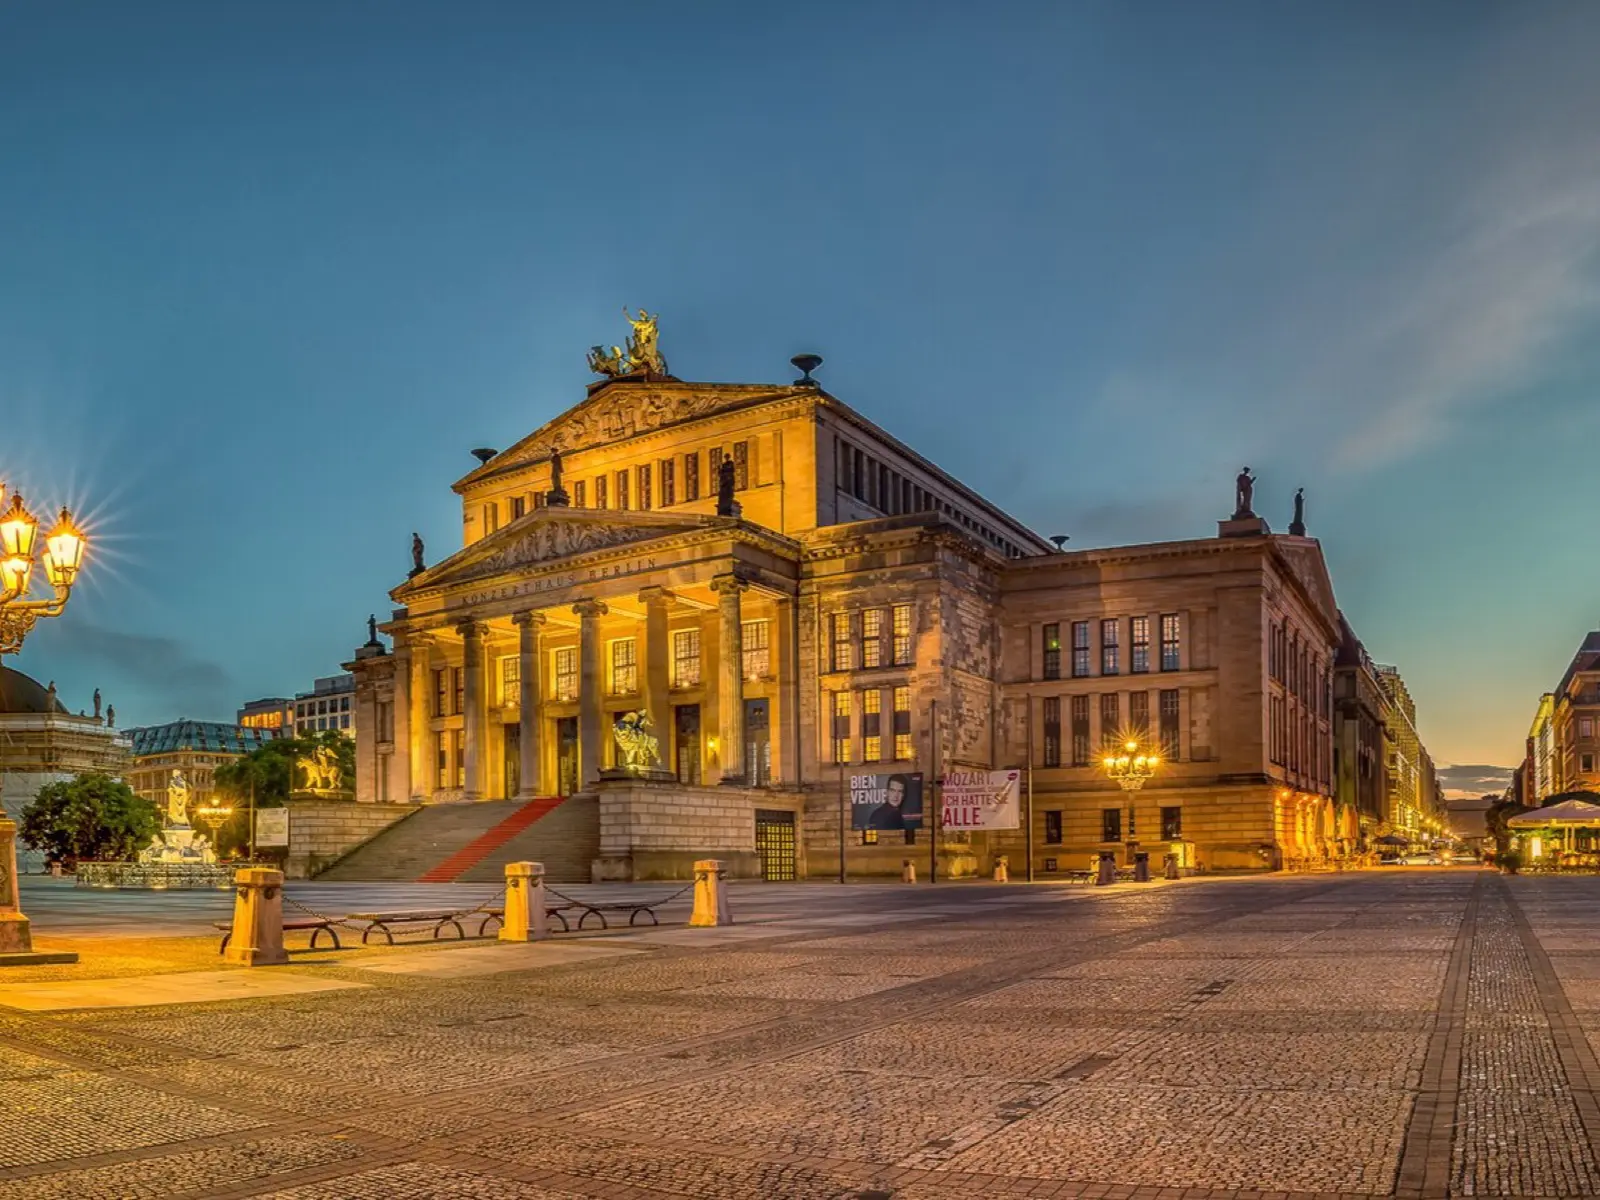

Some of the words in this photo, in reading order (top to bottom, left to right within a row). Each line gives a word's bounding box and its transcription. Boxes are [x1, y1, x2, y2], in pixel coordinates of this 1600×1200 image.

[462, 574, 576, 604] KONZERTHAUS
[589, 558, 656, 582] BERLIN
[851, 775, 877, 789] BIEN
[961, 794, 992, 805] HATTE
[942, 807, 986, 827] ALLE.
